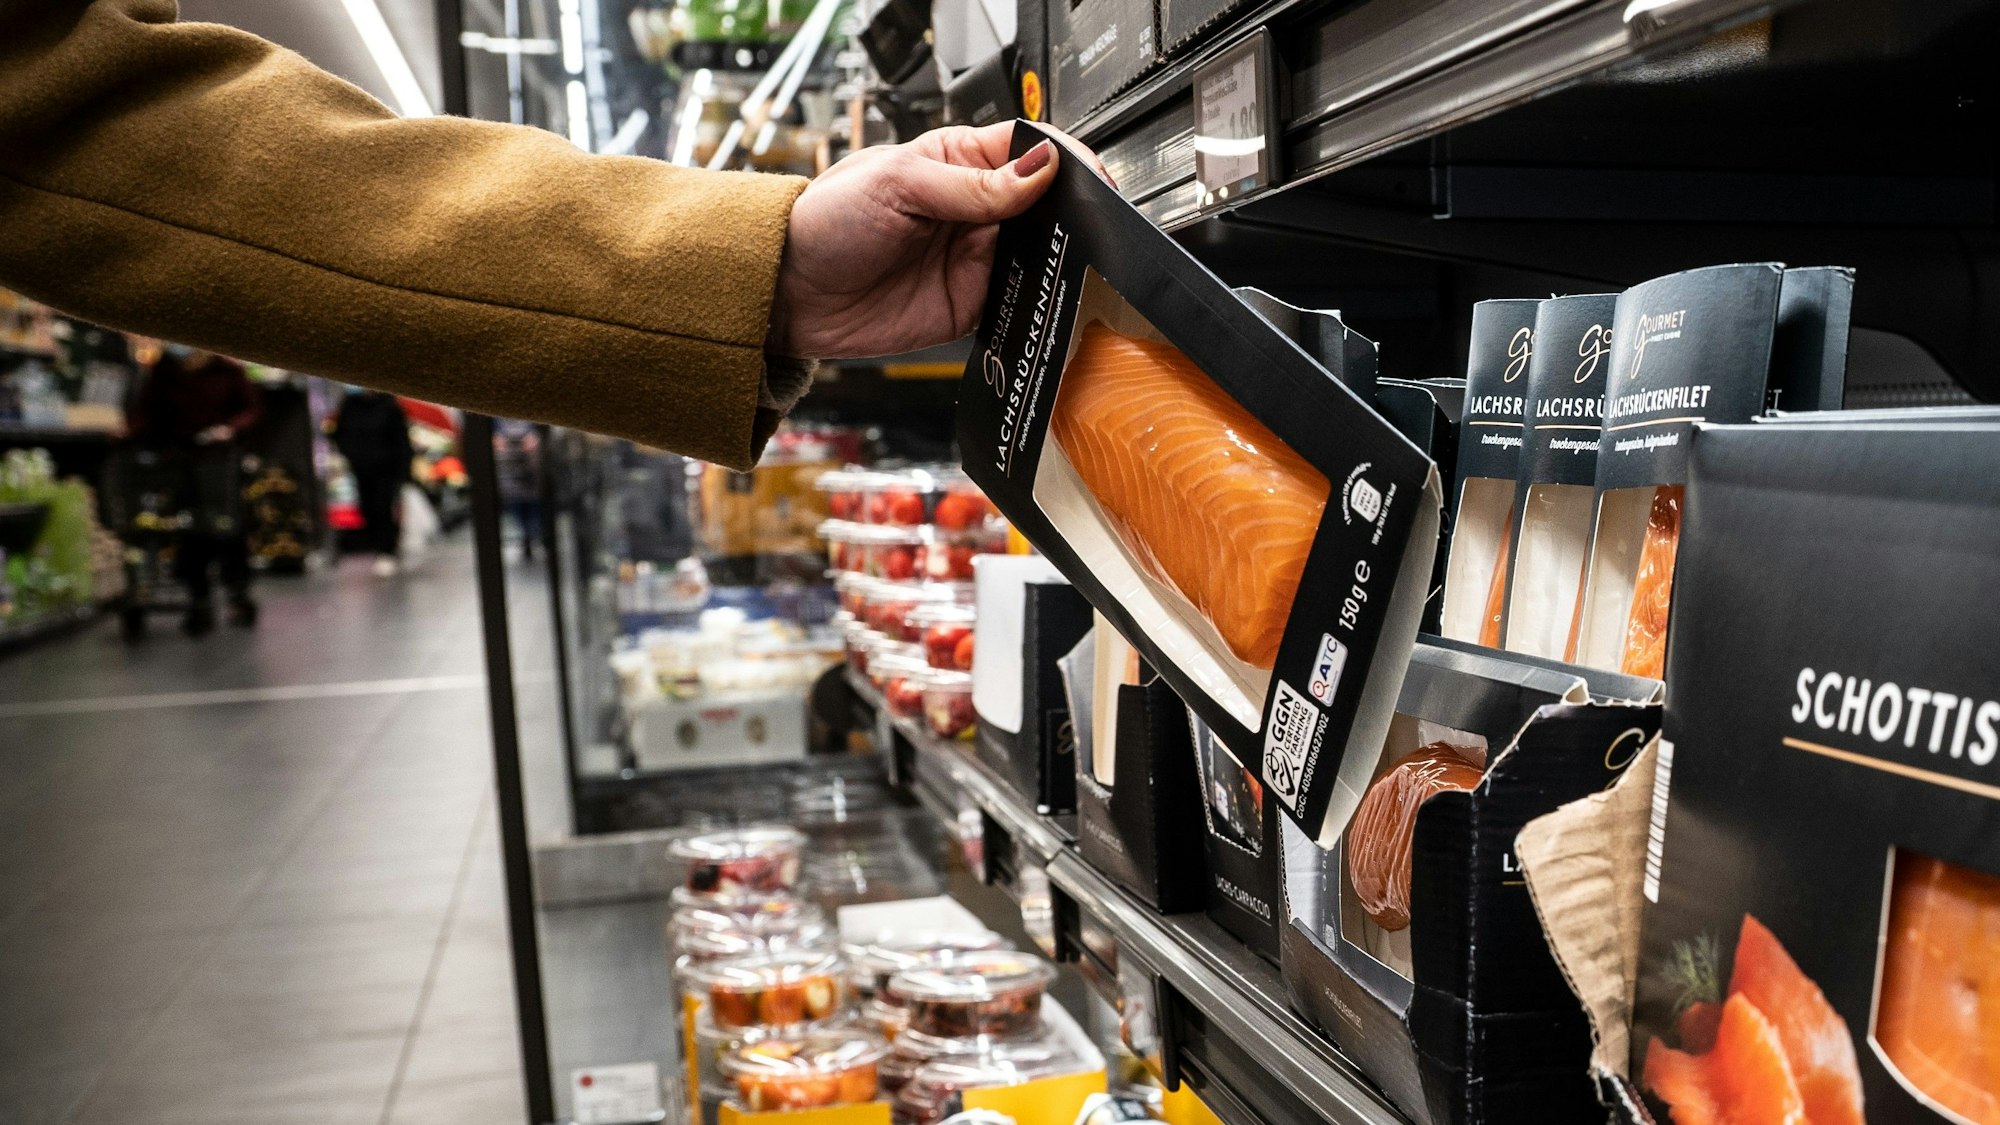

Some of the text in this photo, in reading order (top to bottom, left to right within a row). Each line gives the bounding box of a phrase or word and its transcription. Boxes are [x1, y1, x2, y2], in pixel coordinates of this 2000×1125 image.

[983, 257, 1021, 398] GOURMET
[996, 223, 1065, 473] LACHSRÜCKENFILET
[1630, 310, 1686, 379] GOURMET
[1470, 395, 1527, 415] LACHSR
[1609, 385, 1711, 418] LACHSRÜCKENFILET
[1339, 600, 1360, 631] 150
[1352, 584, 1368, 602] g
[1272, 690, 1294, 742] GGN
[1284, 700, 1302, 750] CERTIFIED
[1291, 706, 1309, 757] FARMING
[1791, 667, 2000, 766] SCHOTTIS
